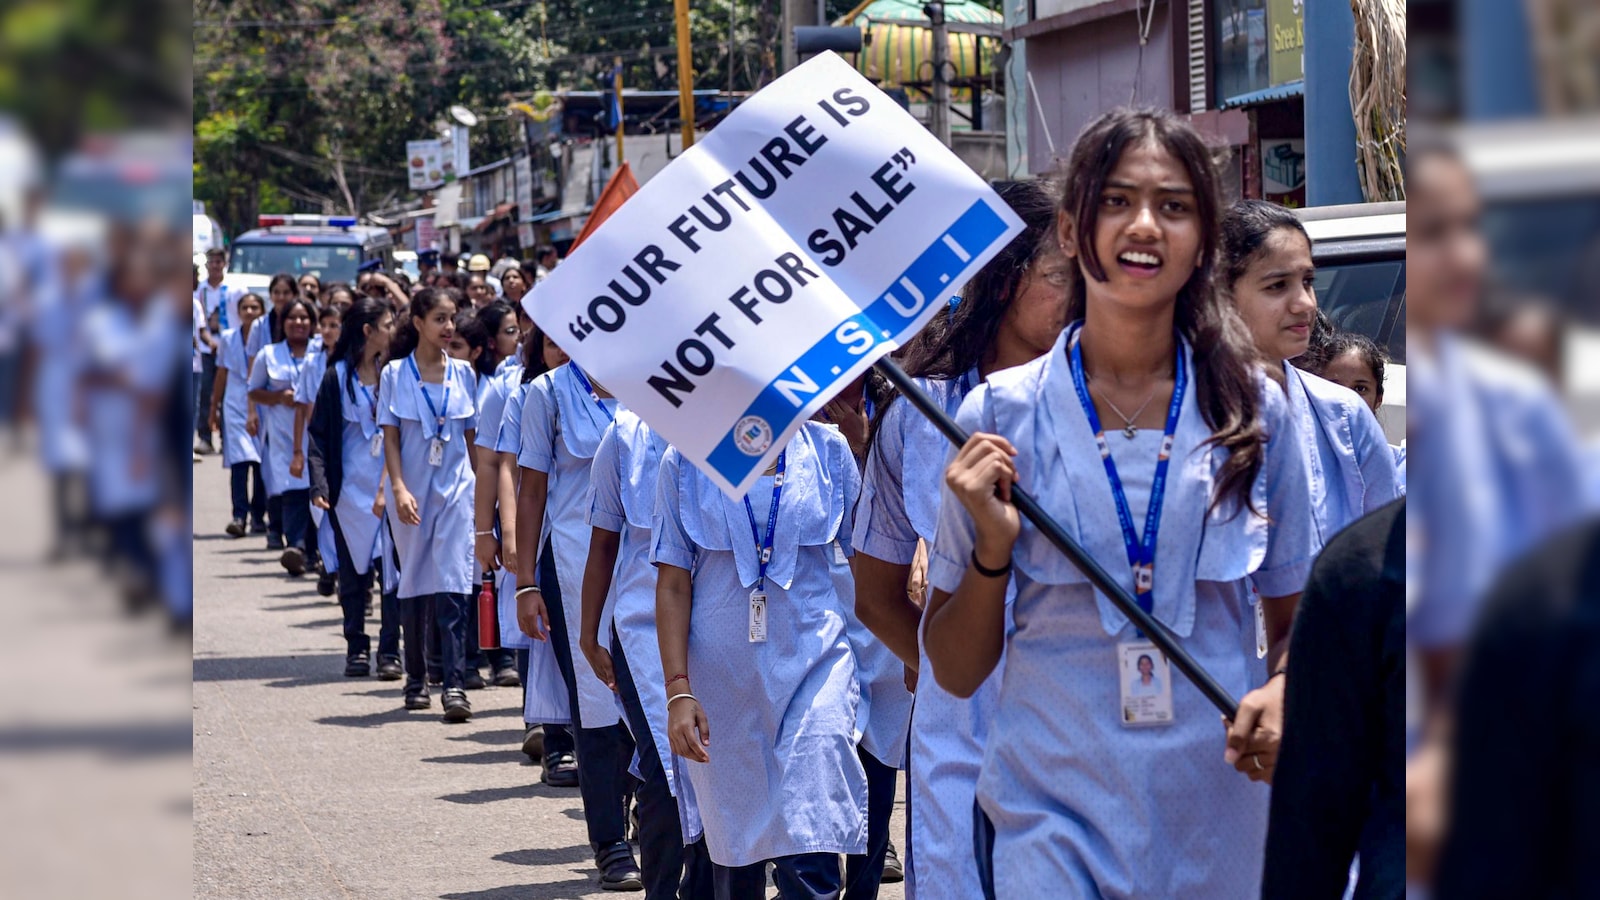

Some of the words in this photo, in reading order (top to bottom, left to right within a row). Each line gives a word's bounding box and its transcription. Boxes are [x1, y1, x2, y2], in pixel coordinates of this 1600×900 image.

[569, 244, 681, 342] “OUR
[667, 115, 828, 253] FUTURE
[818, 88, 870, 128] IS
[647, 312, 736, 409] NOT
[728, 251, 819, 325] FOR
[807, 147, 916, 266] SALE”
